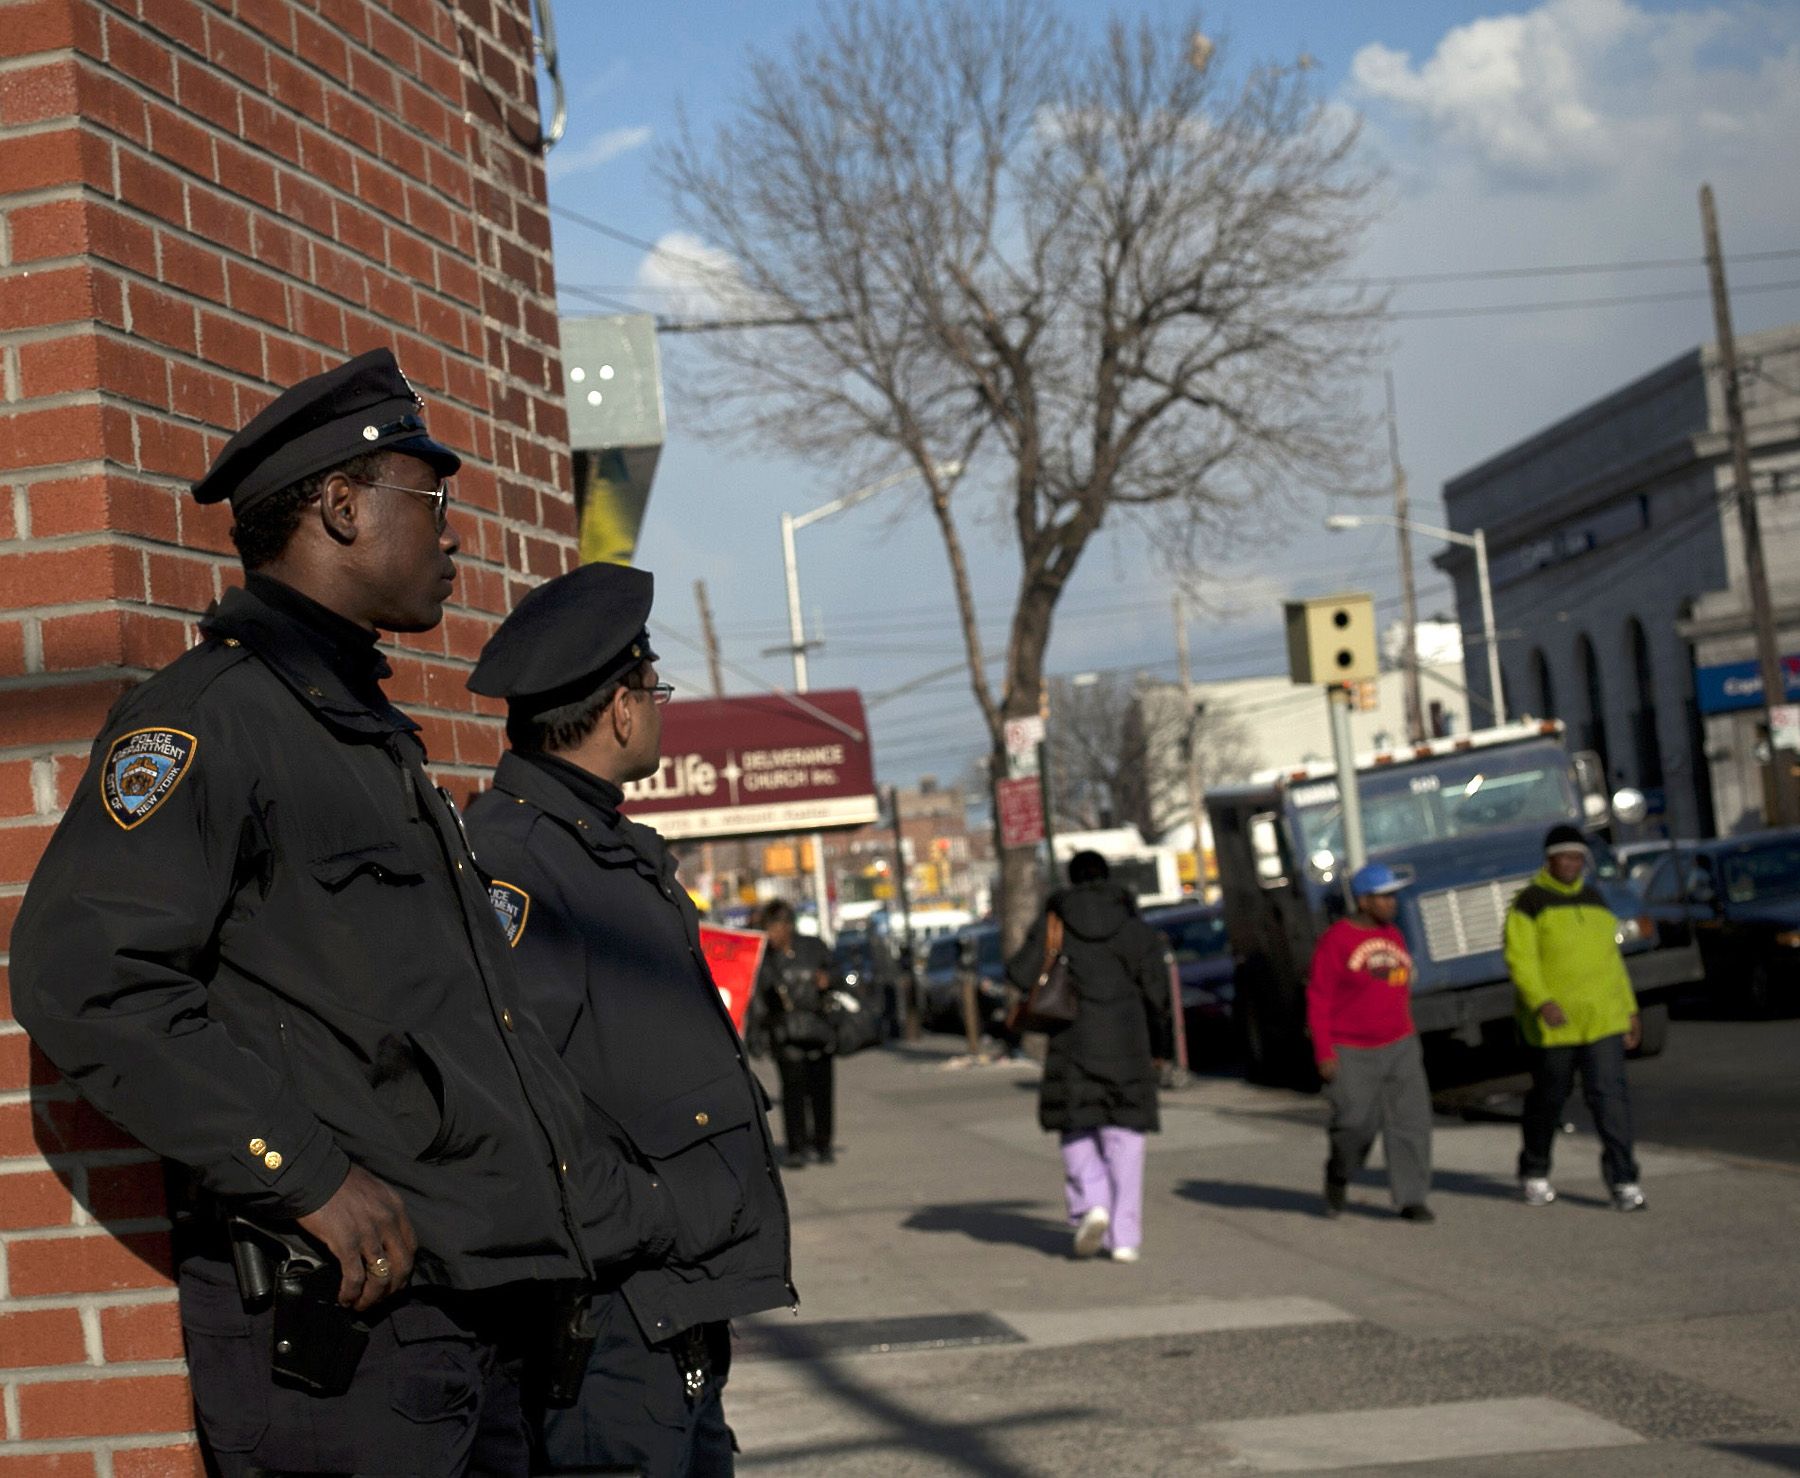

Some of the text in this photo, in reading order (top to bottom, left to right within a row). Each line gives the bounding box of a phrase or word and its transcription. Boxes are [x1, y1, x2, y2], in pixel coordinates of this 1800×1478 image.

[130, 732, 174, 746] POLICE
[112, 741, 186, 763] DEPARTMENT
[742, 744, 844, 771] DELIVERANCE
[136, 794, 158, 816] NEW
[157, 766, 181, 793] YORK
[743, 769, 808, 792] CHURCH
[111, 797, 123, 809] OF
